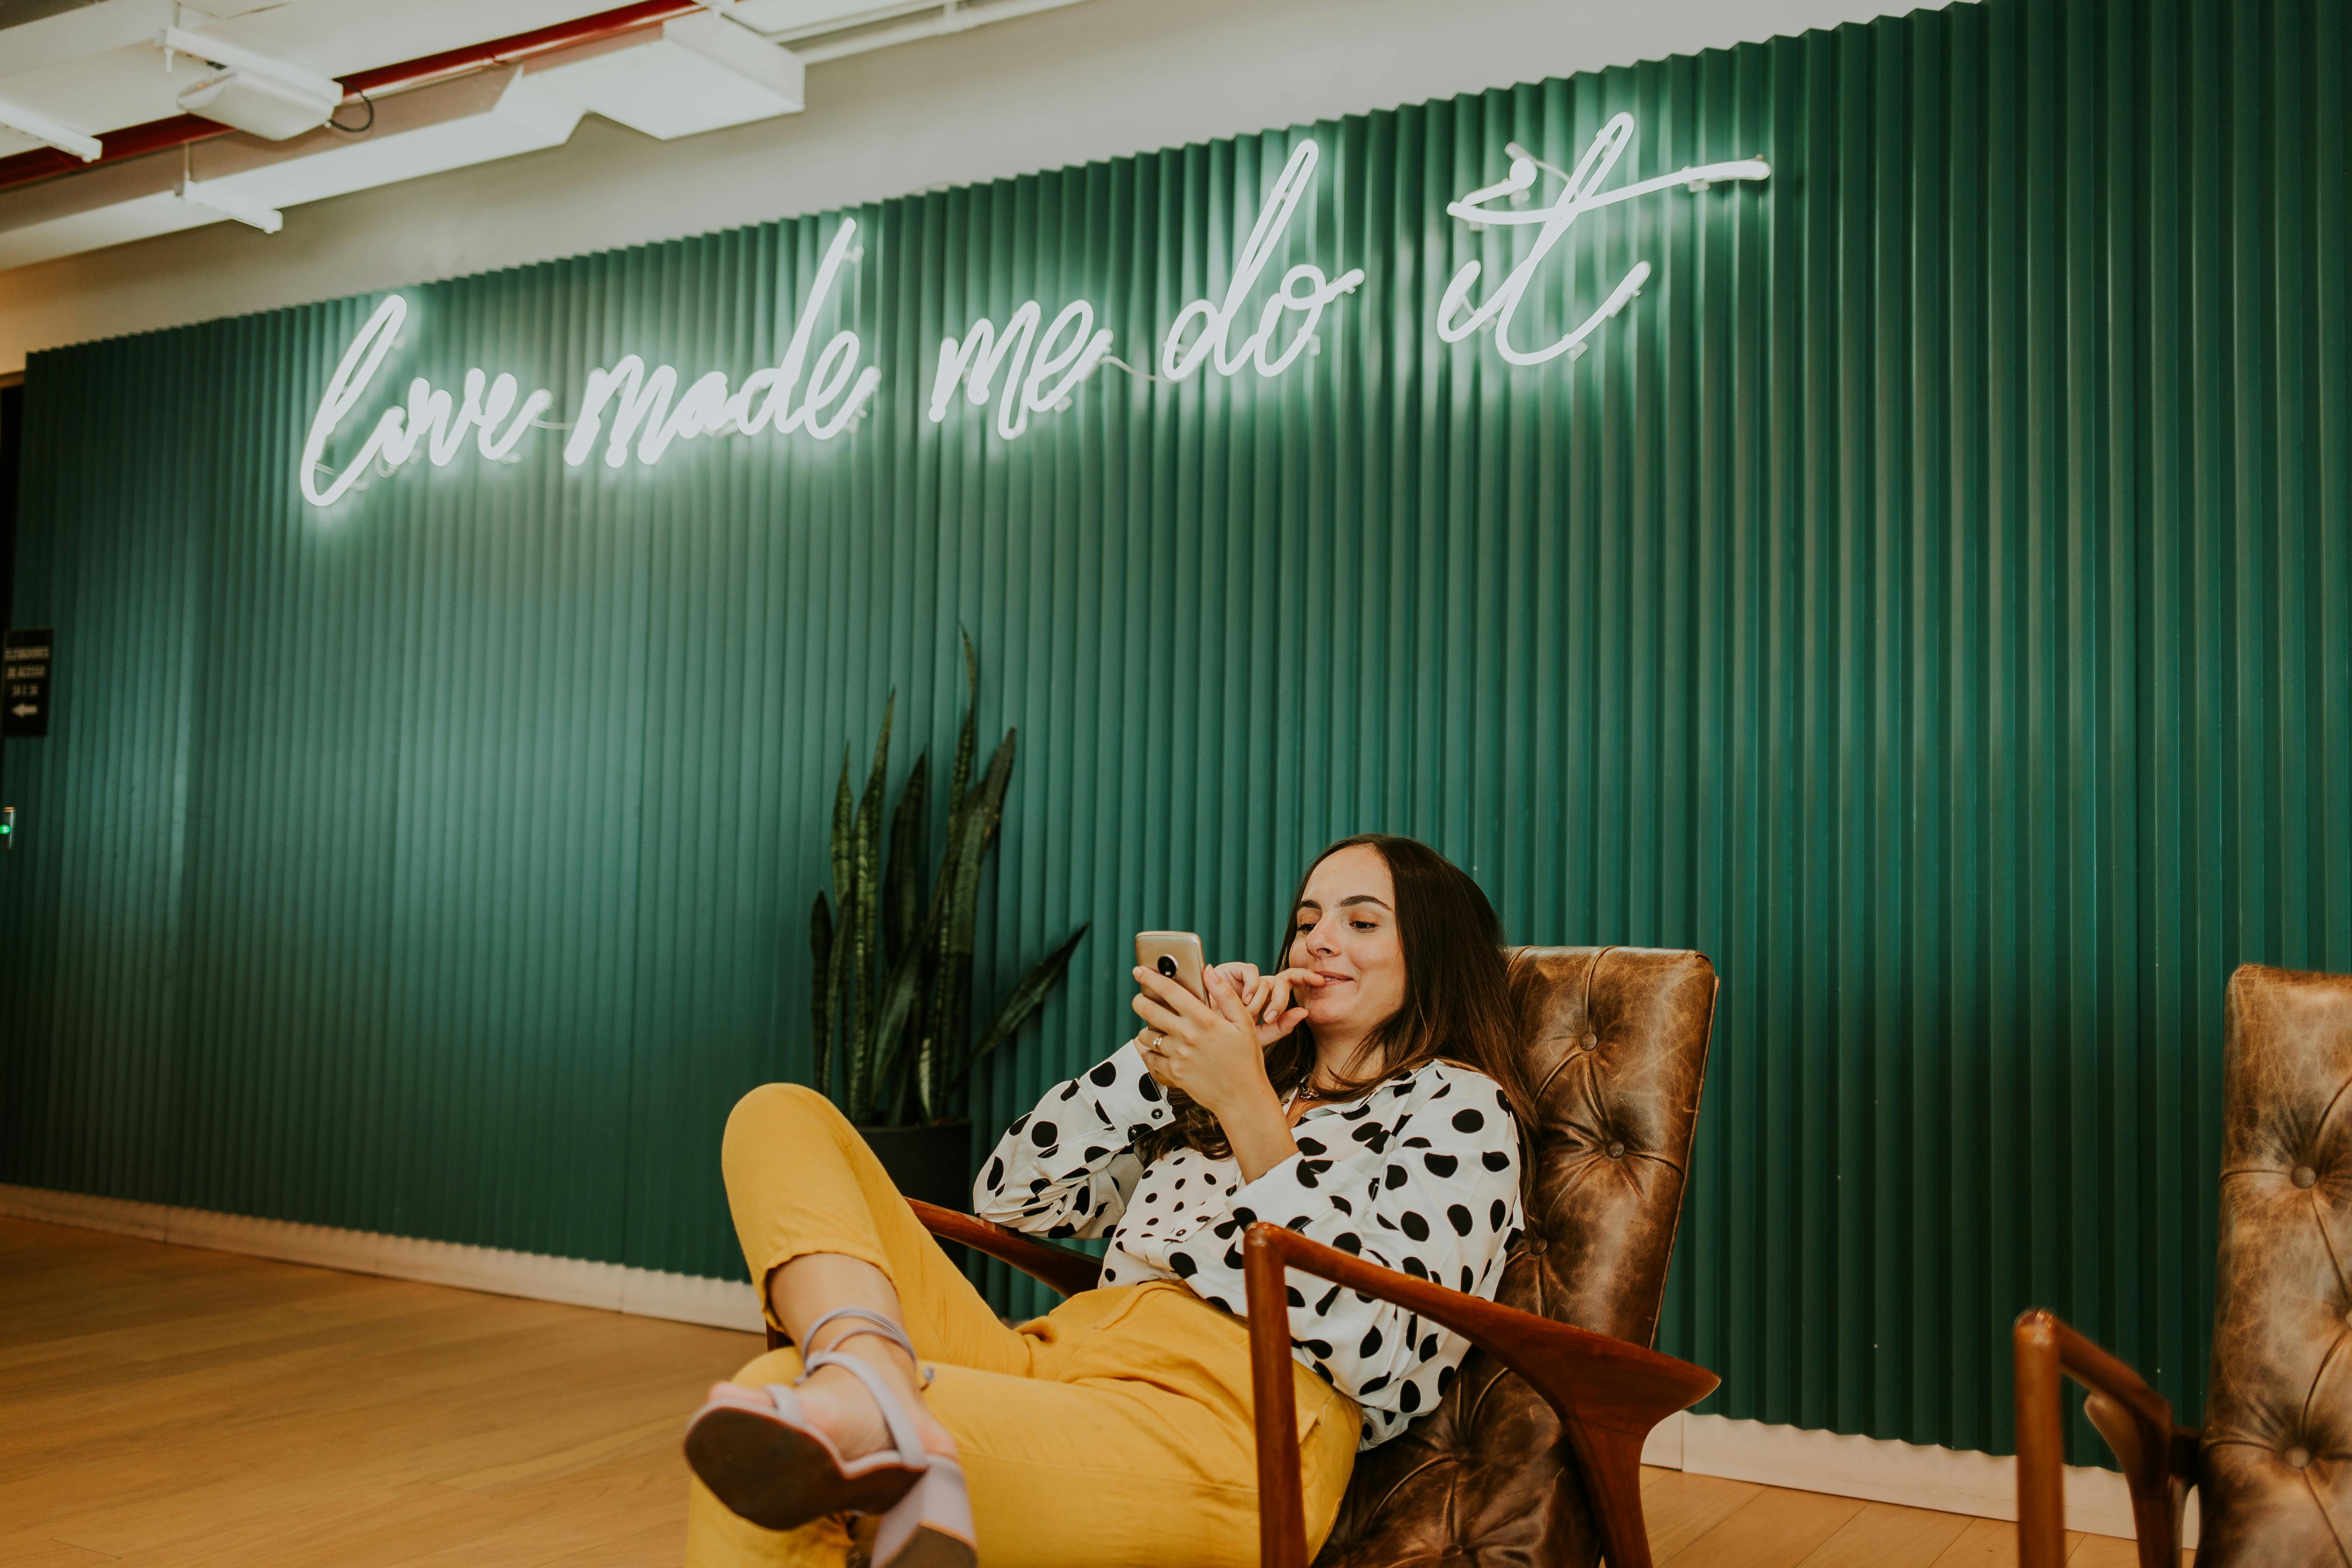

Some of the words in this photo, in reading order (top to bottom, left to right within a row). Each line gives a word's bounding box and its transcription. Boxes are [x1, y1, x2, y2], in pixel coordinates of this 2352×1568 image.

[300, 294, 552, 506] love
[564, 218, 881, 469] made
[928, 300, 1112, 440] me
[1162, 140, 1364, 381] do
[1437, 112, 1770, 366] it
